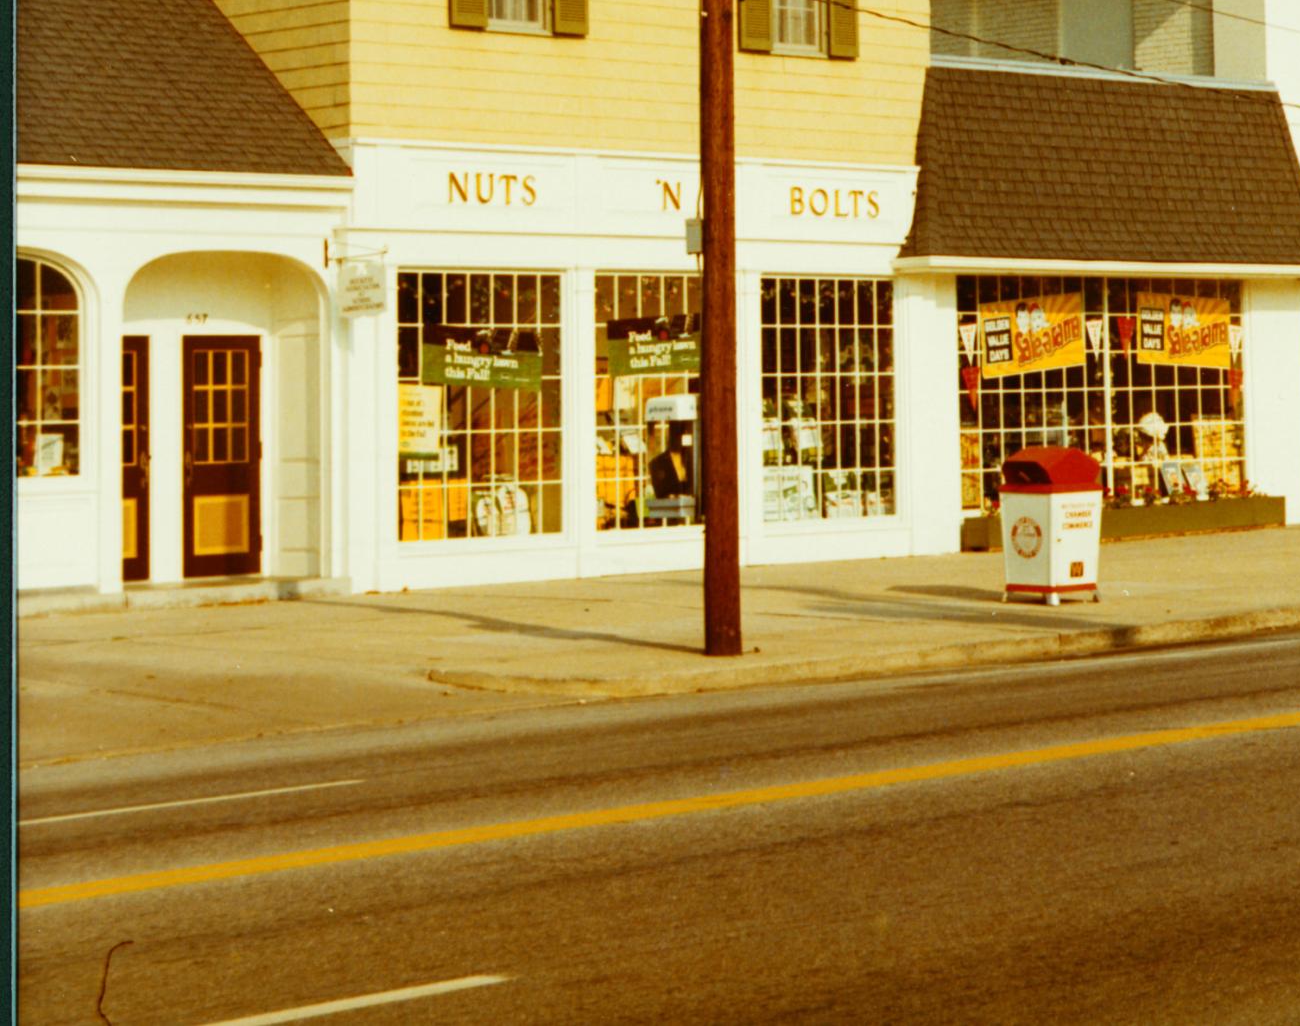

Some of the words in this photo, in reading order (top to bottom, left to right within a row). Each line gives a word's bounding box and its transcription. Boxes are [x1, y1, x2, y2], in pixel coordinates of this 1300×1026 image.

[448, 172, 537, 206] NUTS
[790, 185, 881, 219] BOLTS
[628, 329, 653, 344] Feed
[1142, 323, 1163, 336] VALUE
[446, 339, 472, 353] Feed
[987, 333, 1010, 347] VALUE
[1143, 337, 1162, 351] DAYS
[637, 341, 672, 357] hungry
[672, 340, 697, 352] lawn
[988, 348, 1010, 363] DAYS
[445, 354, 453, 364] a
[454, 352, 493, 369] hungry
[493, 355, 519, 369] lawn
[630, 357, 649, 369] this
[445, 366, 465, 379] this
[648, 405, 673, 415] phone
